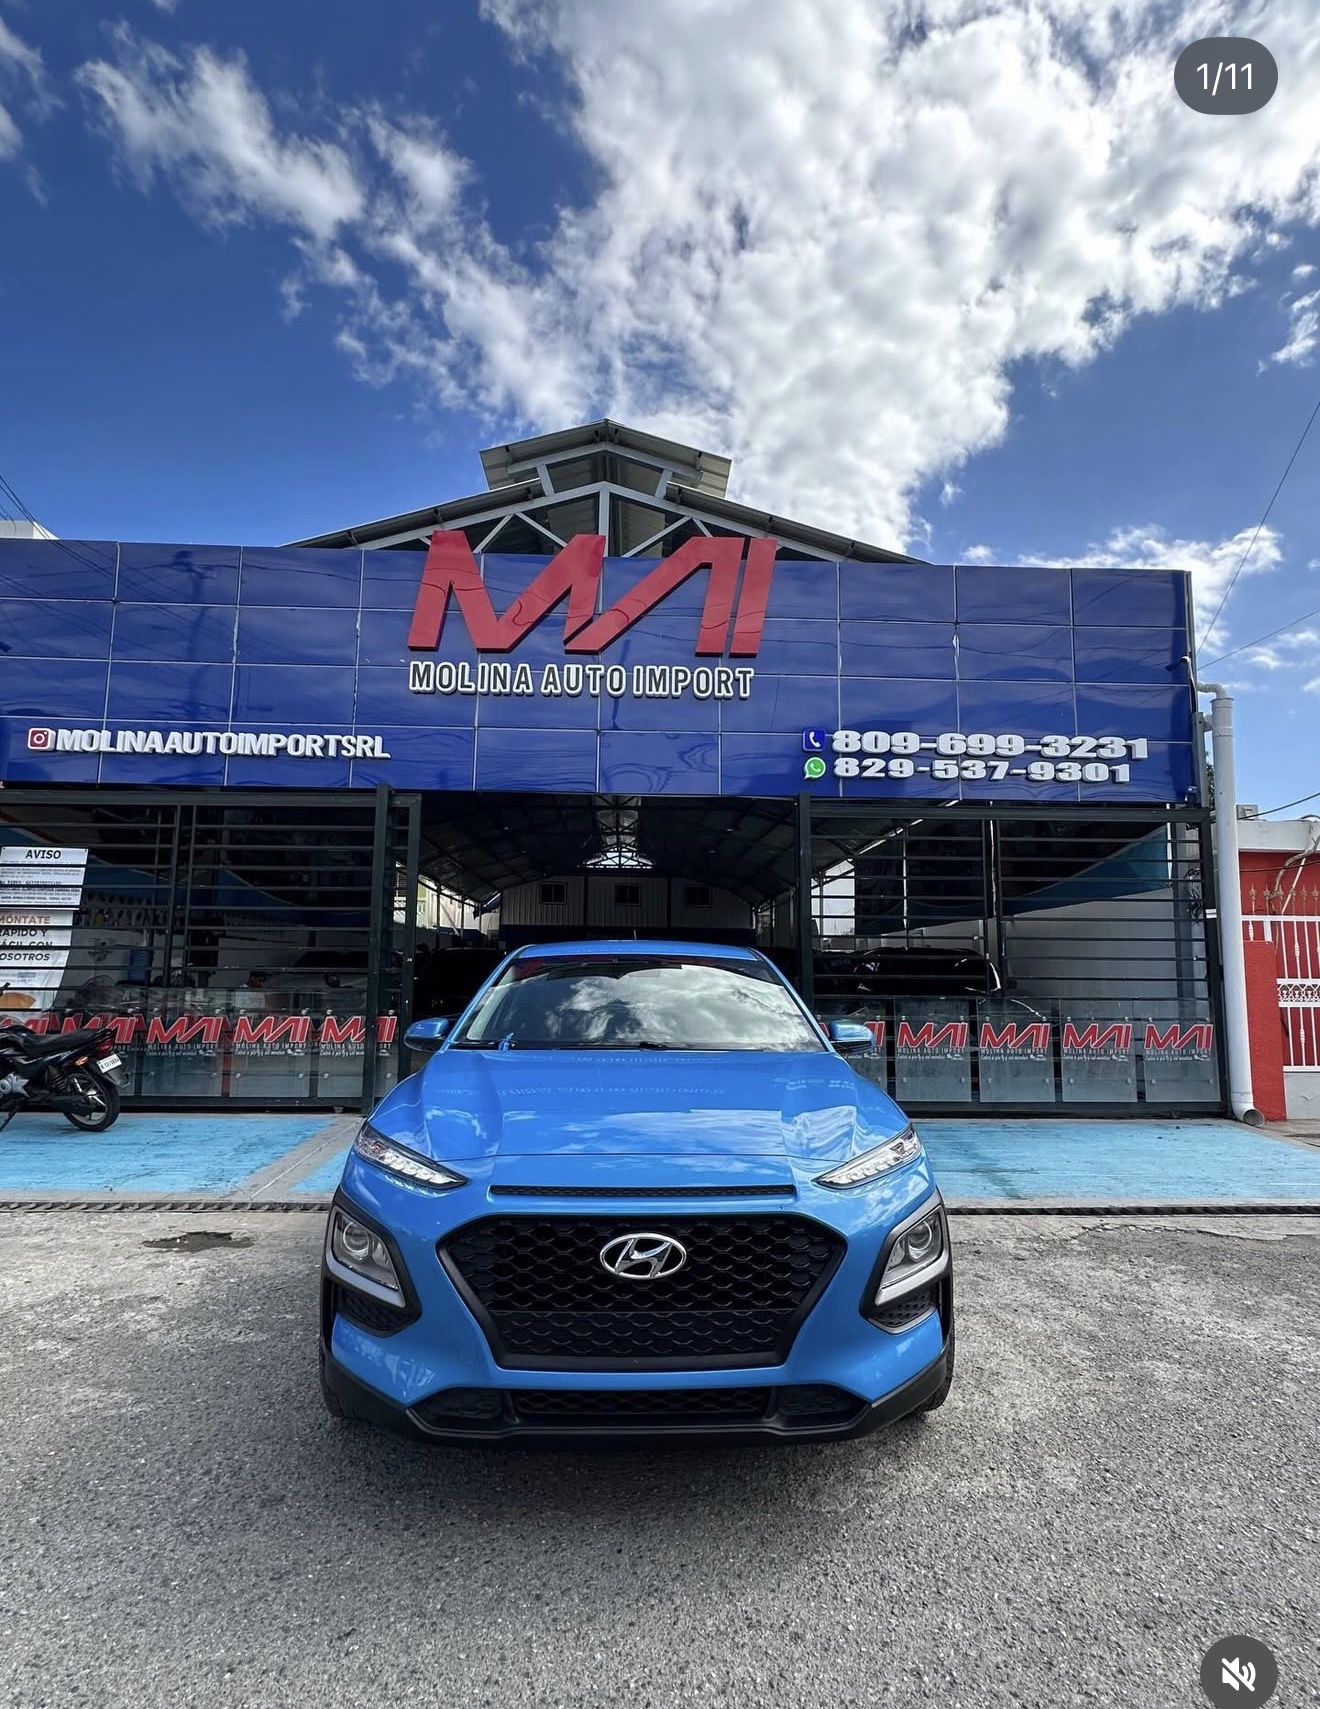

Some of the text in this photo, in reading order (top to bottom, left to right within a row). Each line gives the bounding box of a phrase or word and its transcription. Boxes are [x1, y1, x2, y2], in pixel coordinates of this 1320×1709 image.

[408, 530, 778, 658] MAI
[409, 660, 754, 700] MOLINA AUTO IMPORT
[56, 729, 391, 759] MOLINAAUTOIMPORTSRL
[832, 730, 1149, 760] 809-699-3231
[834, 757, 1130, 783] 829-537-9301
[25, 849, 62, 860] AVISO
